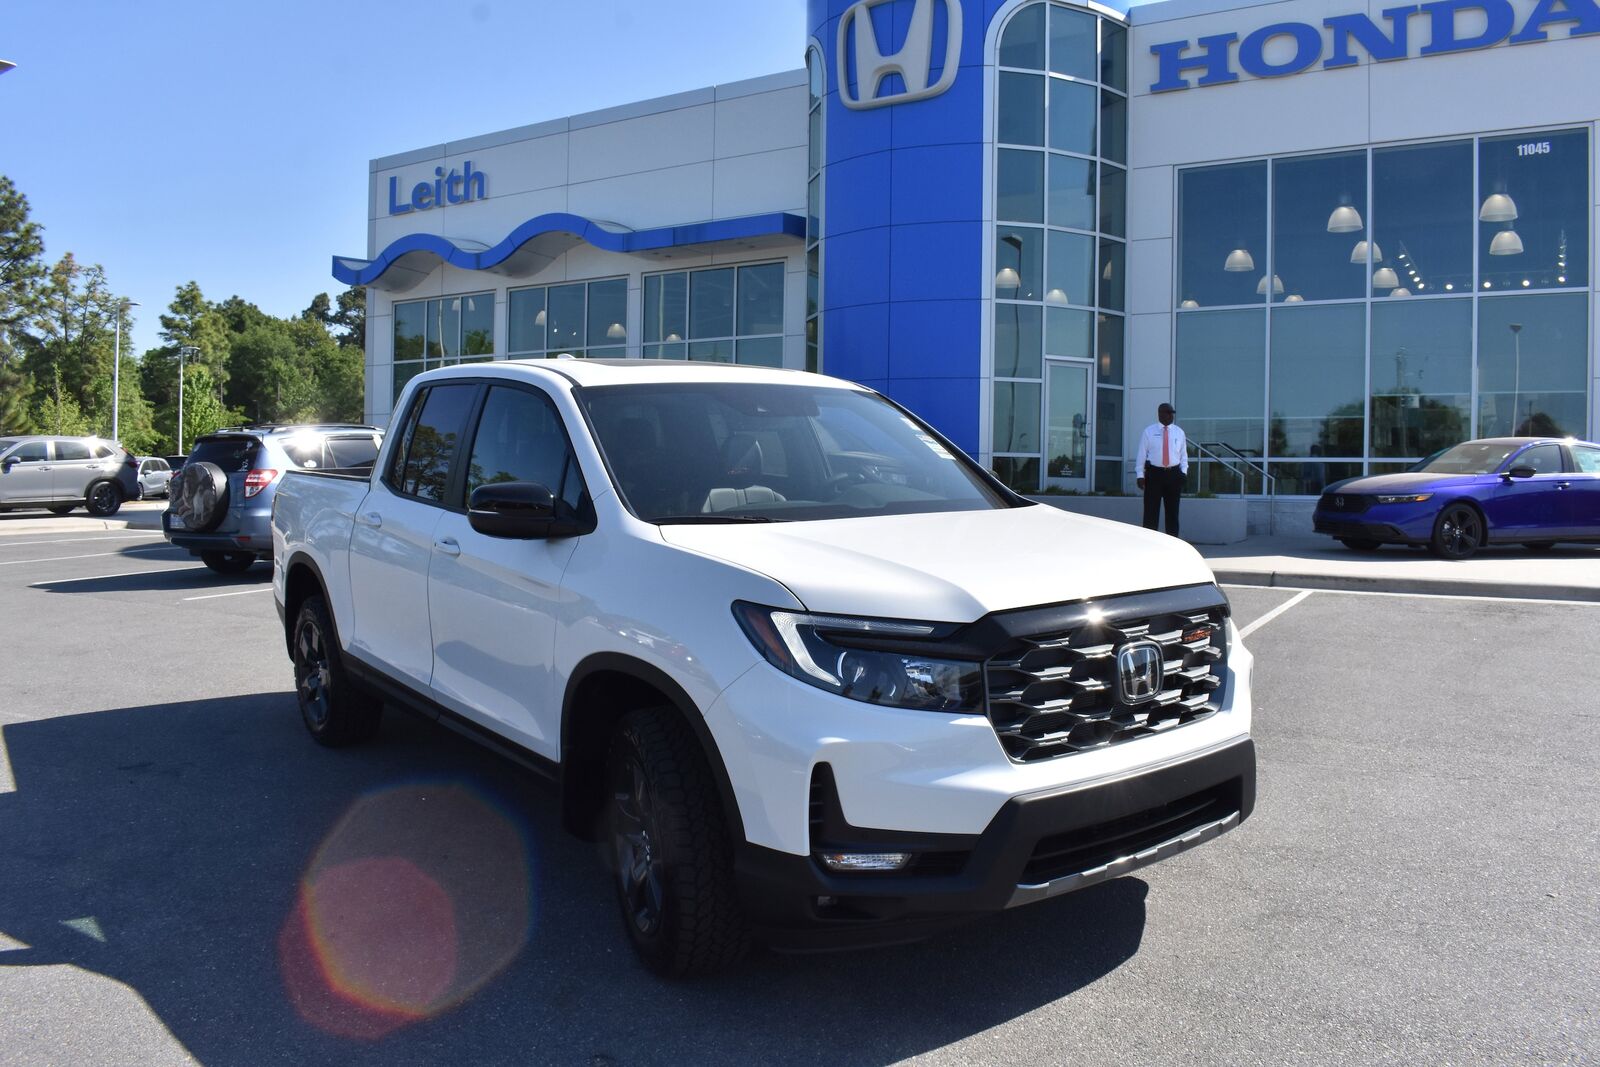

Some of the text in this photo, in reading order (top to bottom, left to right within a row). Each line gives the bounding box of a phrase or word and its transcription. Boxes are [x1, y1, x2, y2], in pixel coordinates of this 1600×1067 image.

[1150, 0, 1600, 93] HONDA
[1517, 142, 1551, 156] 11045
[389, 160, 486, 215] Leith
